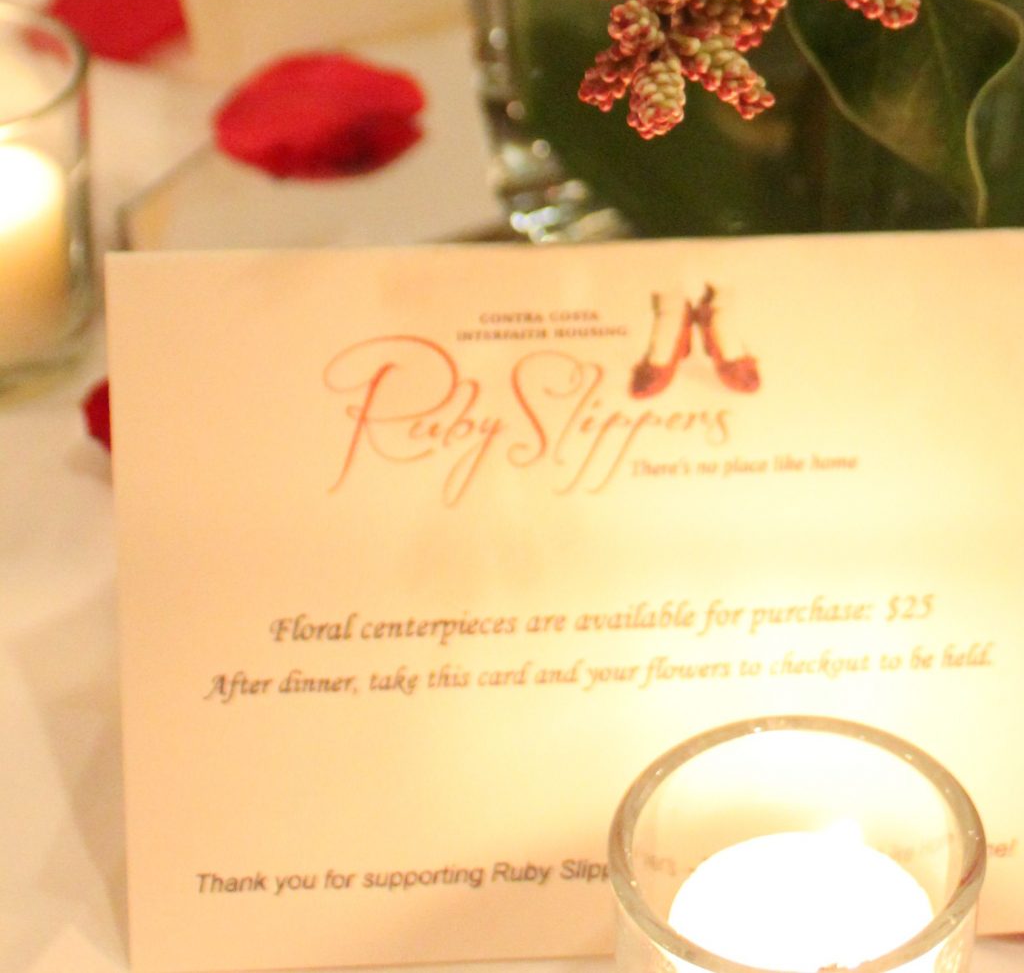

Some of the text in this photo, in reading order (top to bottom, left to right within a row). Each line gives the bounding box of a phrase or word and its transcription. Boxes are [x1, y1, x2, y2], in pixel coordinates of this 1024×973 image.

[456, 325, 628, 342] INTERFAITH HOUSING
[479, 308, 599, 324] CONTRA COSTA
[323, 334, 734, 508] Ruby Slippers
[630, 451, 859, 479] There's no place like home
[269, 593, 936, 645] Floral centerpieces are available for purchase: $25
[203, 640, 997, 704] After dinner, take this card and your flowers to checkout to be held.
[197, 871, 267, 895] Thank
[274, 872, 317, 896] you
[323, 868, 355, 891] for
[361, 864, 485, 891] supporting
[491, 860, 553, 886] Ruby
